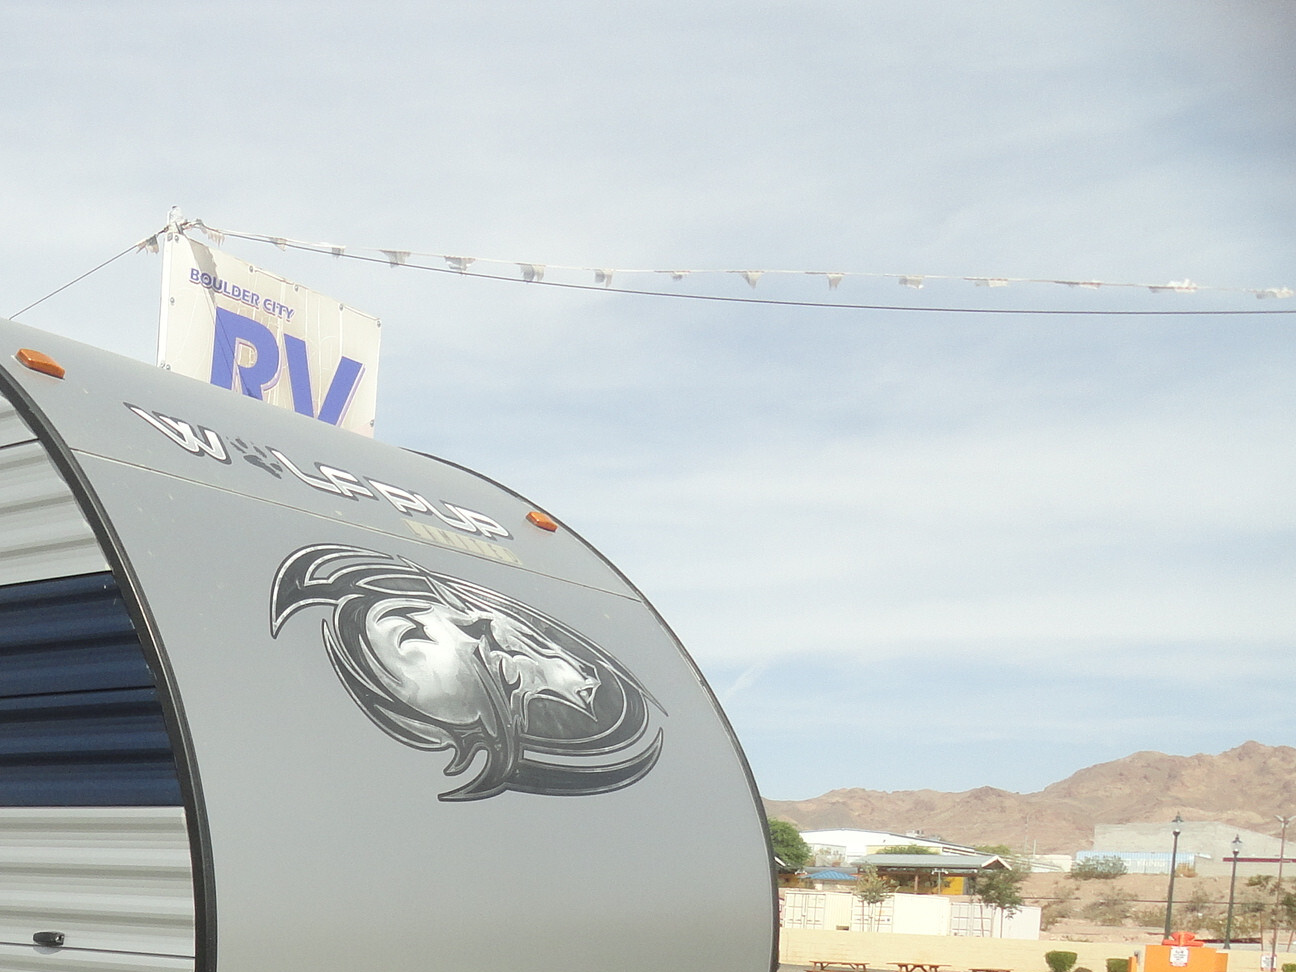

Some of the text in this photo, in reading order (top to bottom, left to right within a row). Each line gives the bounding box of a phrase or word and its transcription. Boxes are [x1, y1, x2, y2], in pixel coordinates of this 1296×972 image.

[190, 268, 294, 322] BOULDER CITY
[210, 306, 365, 427] RV
[363, 475, 515, 541] PUP
[403, 518, 521, 563] LIMITED
